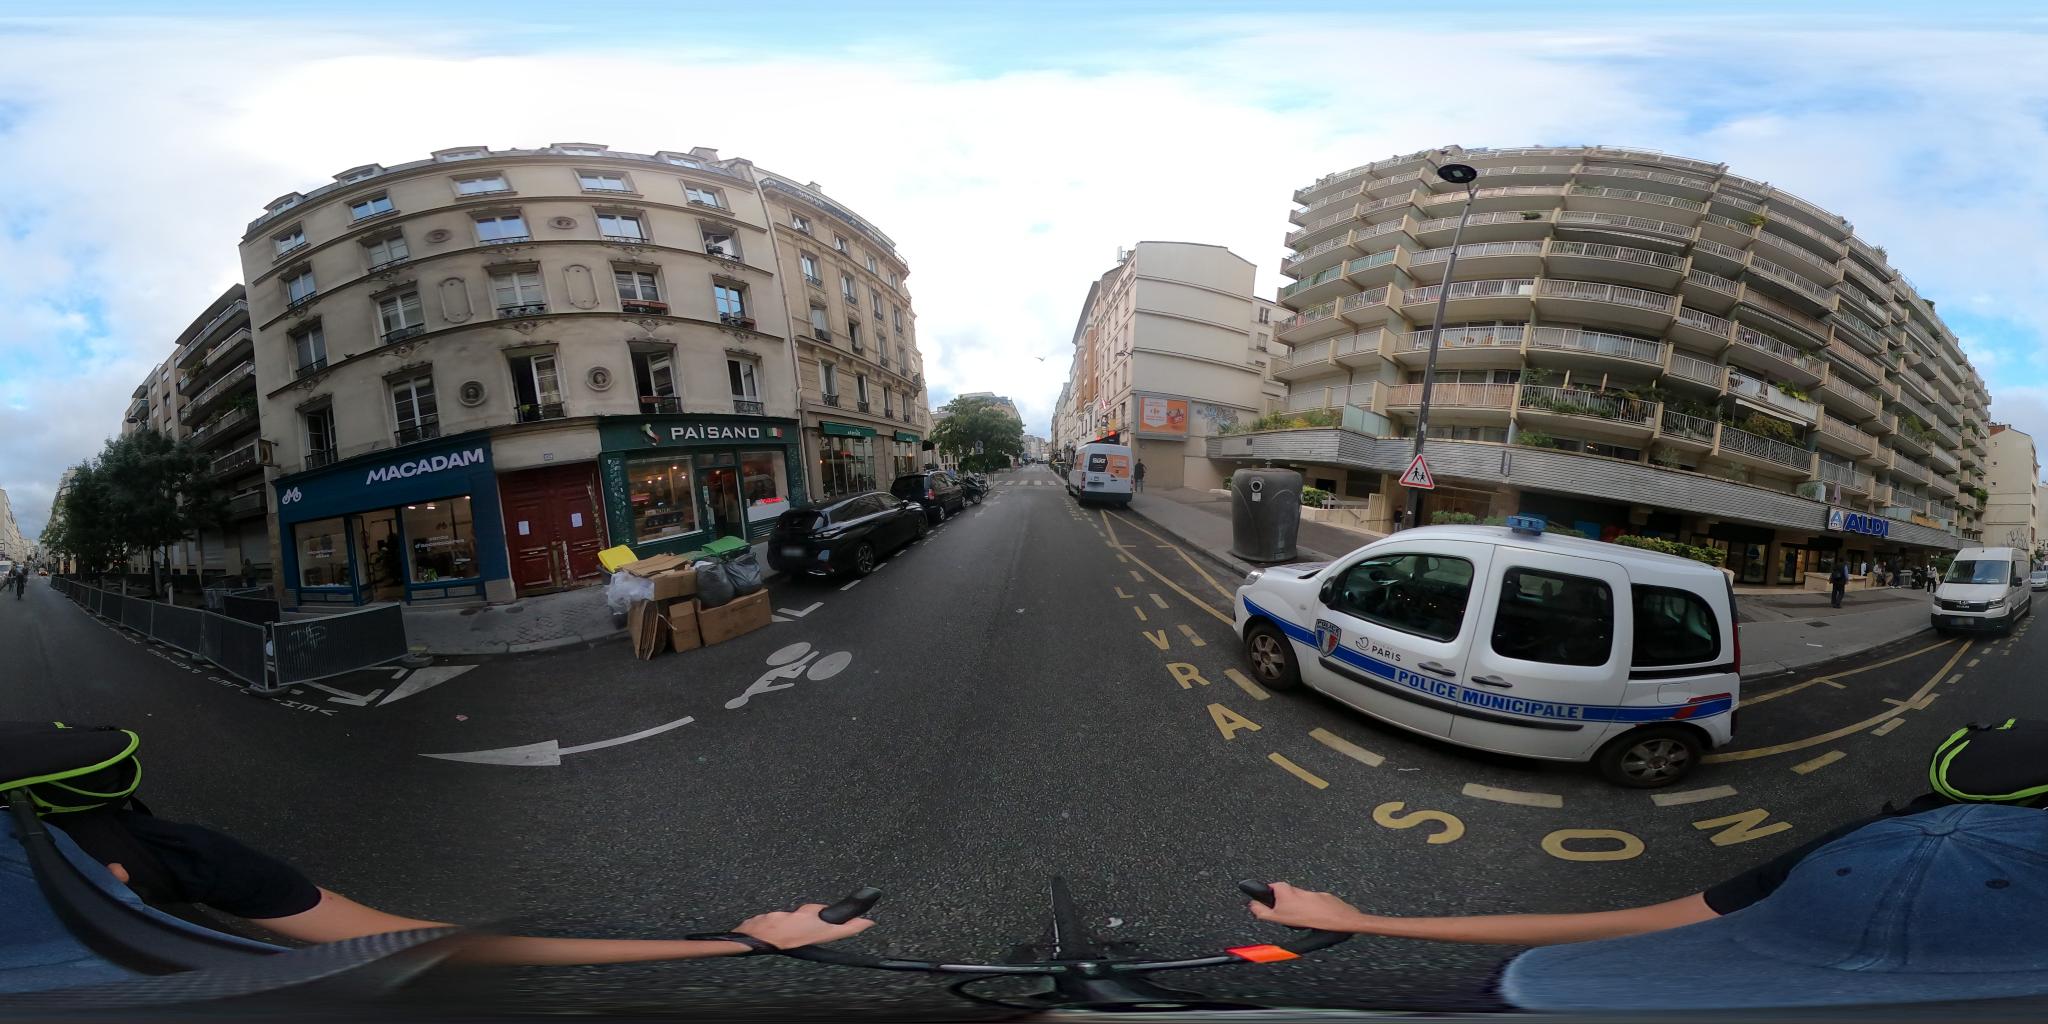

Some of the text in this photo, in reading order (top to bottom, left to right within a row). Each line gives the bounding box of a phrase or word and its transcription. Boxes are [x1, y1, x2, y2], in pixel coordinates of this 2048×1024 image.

[365, 447, 485, 485] MACADAM
[1844, 512, 1889, 538] ALDI
[1317, 620, 1340, 633] POLICE
[1371, 645, 1401, 662] PARIS
[1399, 670, 1580, 720] POLICE MUNICIPALE
[1114, 586, 1794, 862] LIVRAISON
